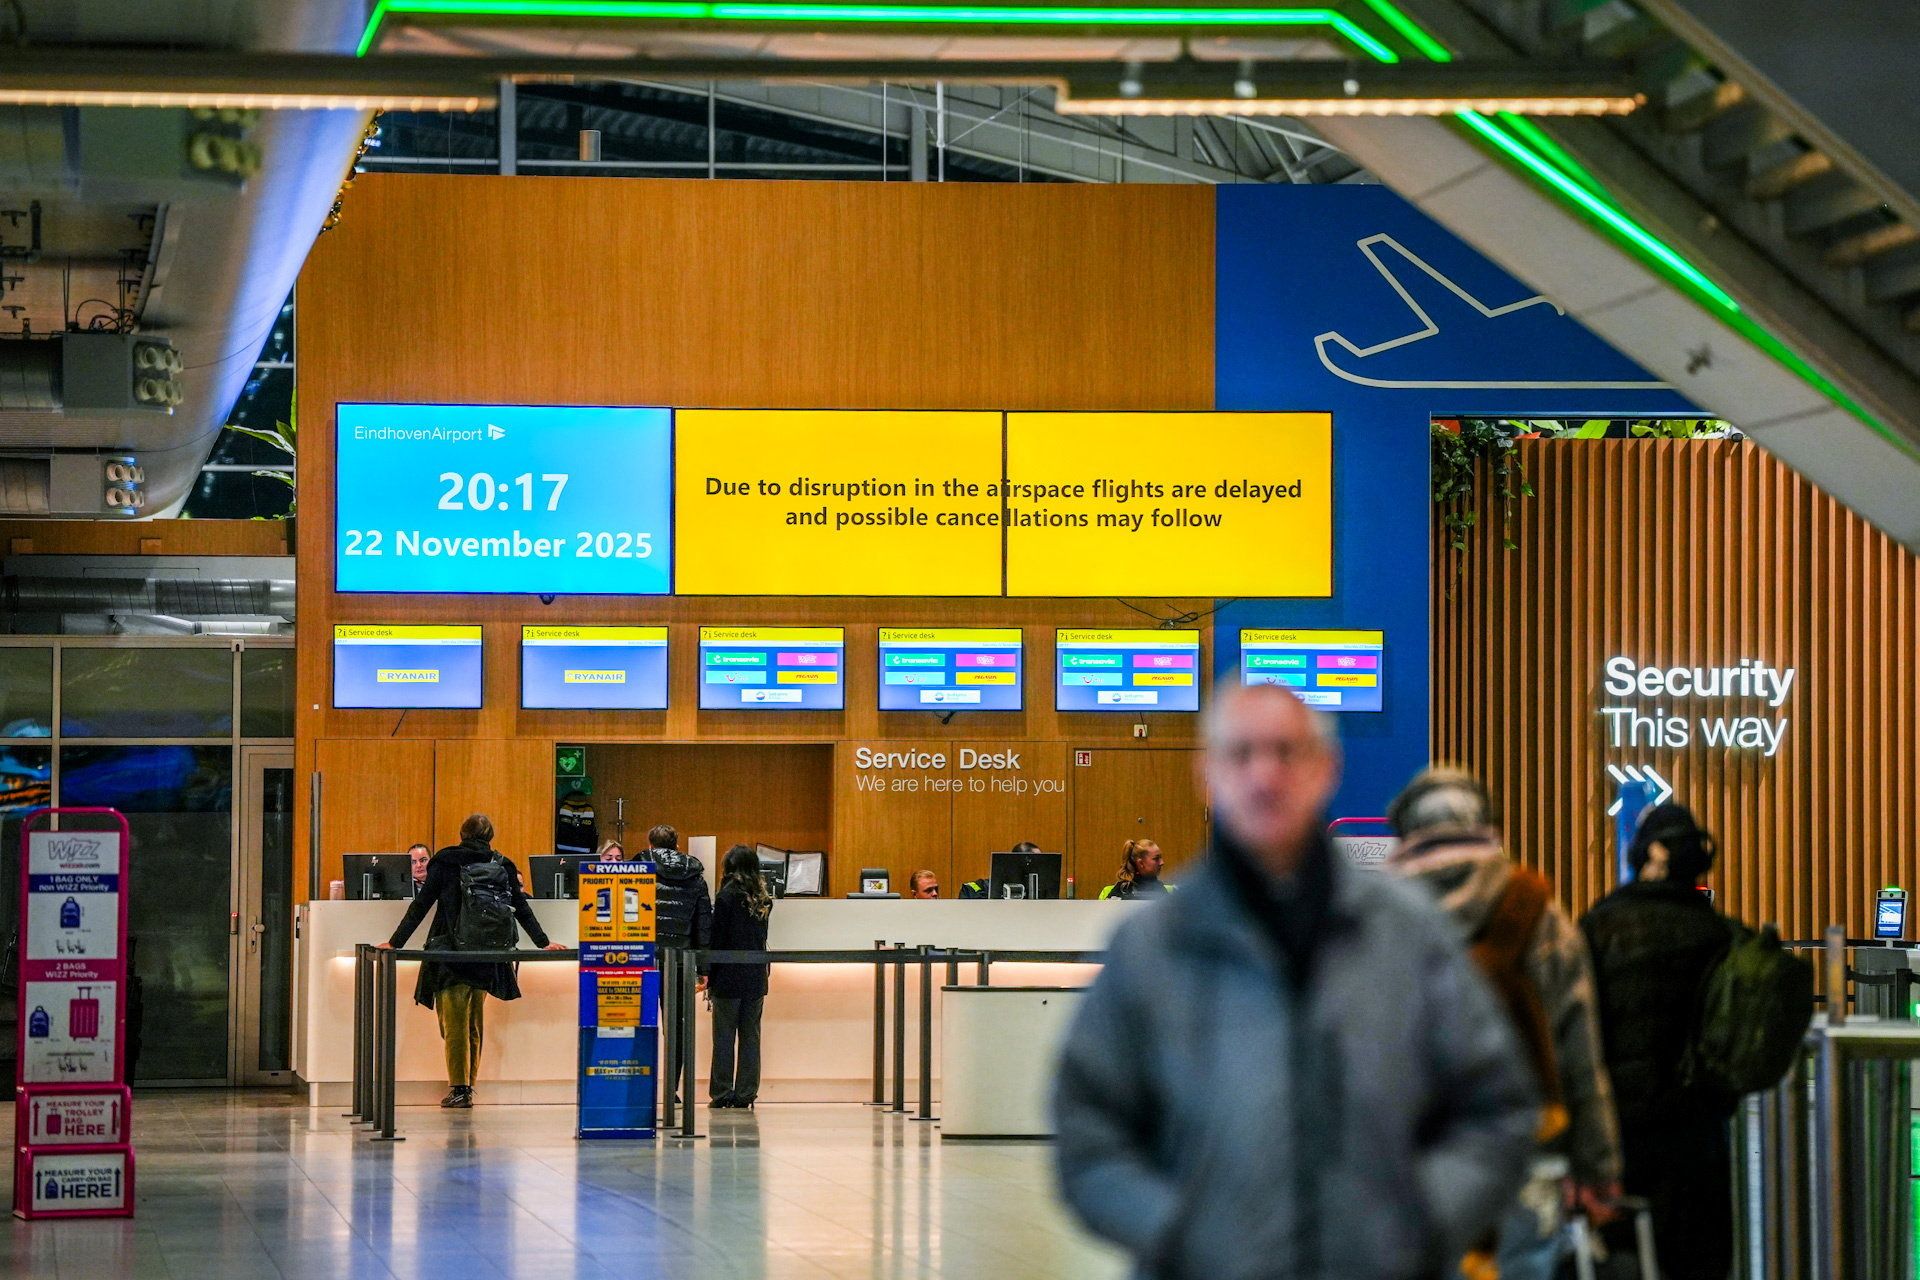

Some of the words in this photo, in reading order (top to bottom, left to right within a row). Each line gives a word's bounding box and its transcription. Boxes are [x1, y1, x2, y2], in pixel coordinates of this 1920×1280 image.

[354, 425, 483, 443] EindhovenAirport
[438, 472, 569, 511] 20:17
[705, 477, 750, 496] Due
[758, 479, 781, 496] to
[789, 477, 906, 501] disruption
[914, 478, 934, 496] in
[943, 478, 979, 497] the
[986, 479, 1084, 502] airspace
[1092, 479, 1164, 503] flights
[1171, 483, 1207, 498] are
[1214, 479, 1302, 503] delayed
[785, 506, 827, 525] and
[836, 507, 928, 531] possible
[936, 507, 1088, 527] cancellations
[1096, 512, 1143, 532] may
[1151, 508, 1223, 527] follow
[345, 530, 382, 556] 22
[395, 530, 566, 557] November
[575, 532, 652, 558] 2025
[387, 672, 437, 680] RYANAIR
[1604, 656, 1795, 707] Security
[1601, 707, 1689, 747] This
[1701, 717, 1787, 757] way
[855, 747, 946, 770] Service
[959, 748, 1021, 770] Desk
[856, 775, 886, 792] We
[891, 779, 919, 792] are
[924, 776, 963, 792] here
[969, 777, 985, 792] to
[991, 776, 1028, 795] help
[1033, 779, 1065, 796] you
[596, 864, 648, 873] RYANAIR
[55, 875, 74, 883] BAG
[75, 875, 99, 883] ONLY
[80, 884, 109, 892] Priority
[70, 971, 98, 979] Priority
[65, 1108, 104, 1116] TROLLEY
[65, 1124, 105, 1136] HERE
[61, 1183, 112, 1198] HERE
